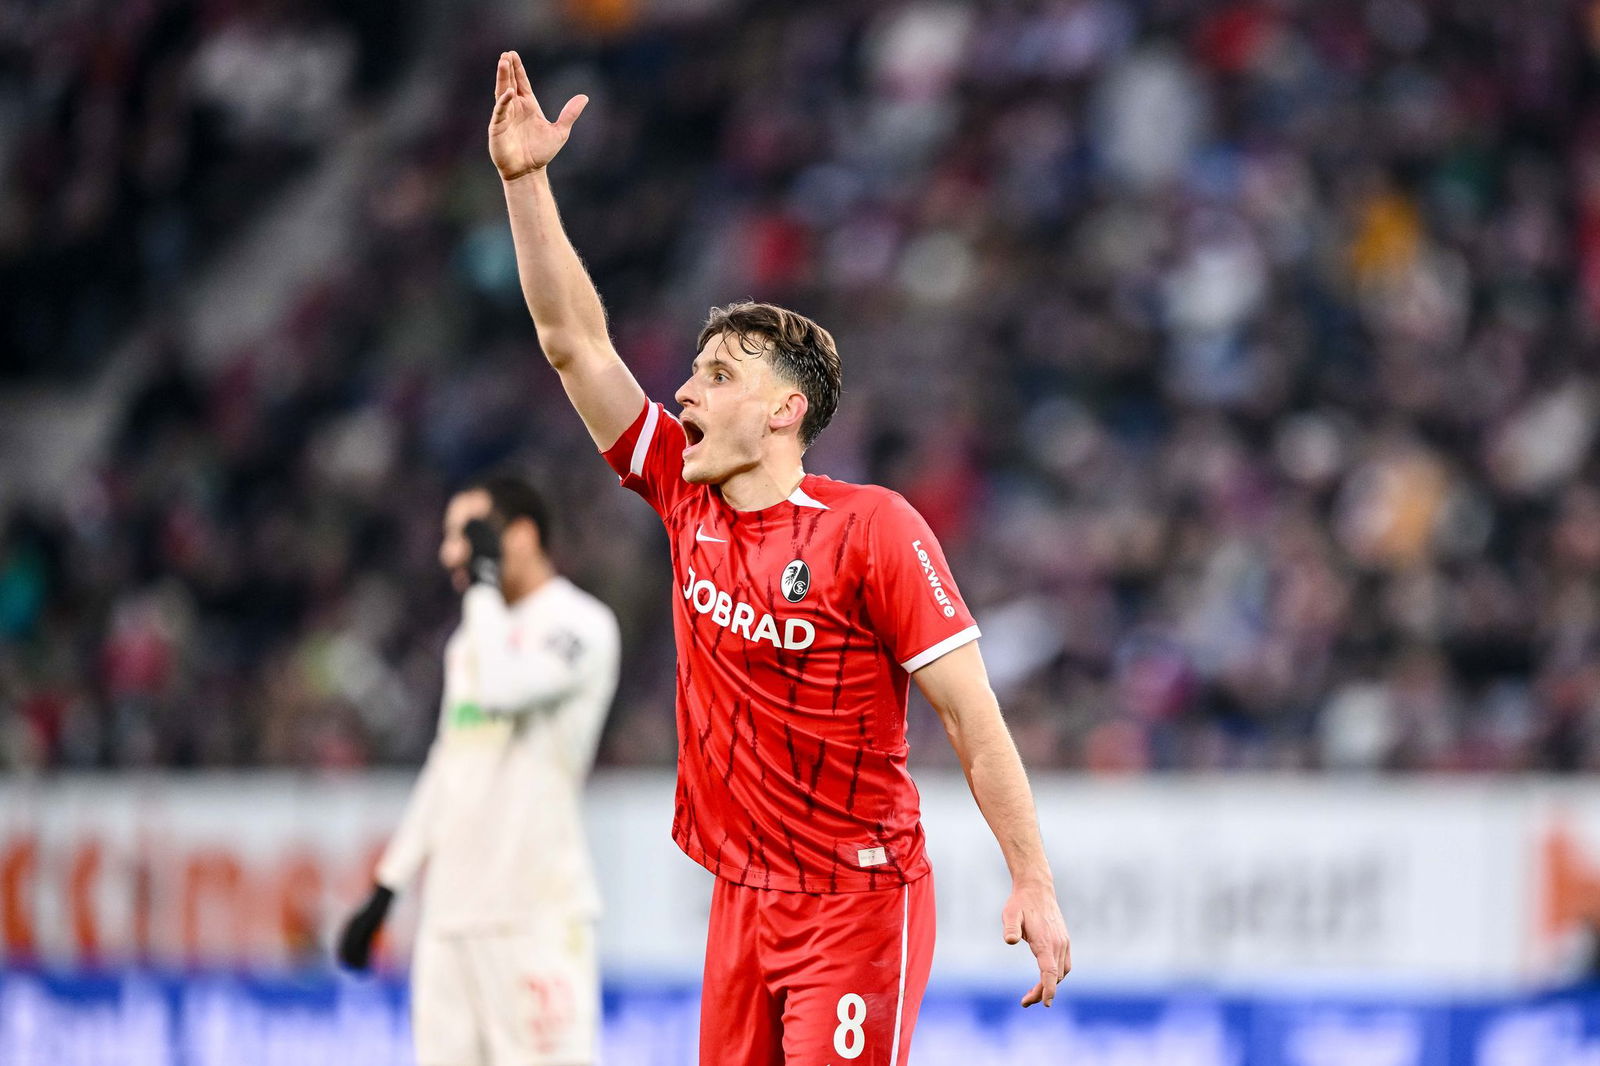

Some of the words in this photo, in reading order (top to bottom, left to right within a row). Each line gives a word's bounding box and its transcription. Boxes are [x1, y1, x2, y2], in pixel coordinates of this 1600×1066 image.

[682, 565, 816, 651] JOBRAD
[911, 539, 956, 618] Lexware
[832, 992, 867, 1060] 8
